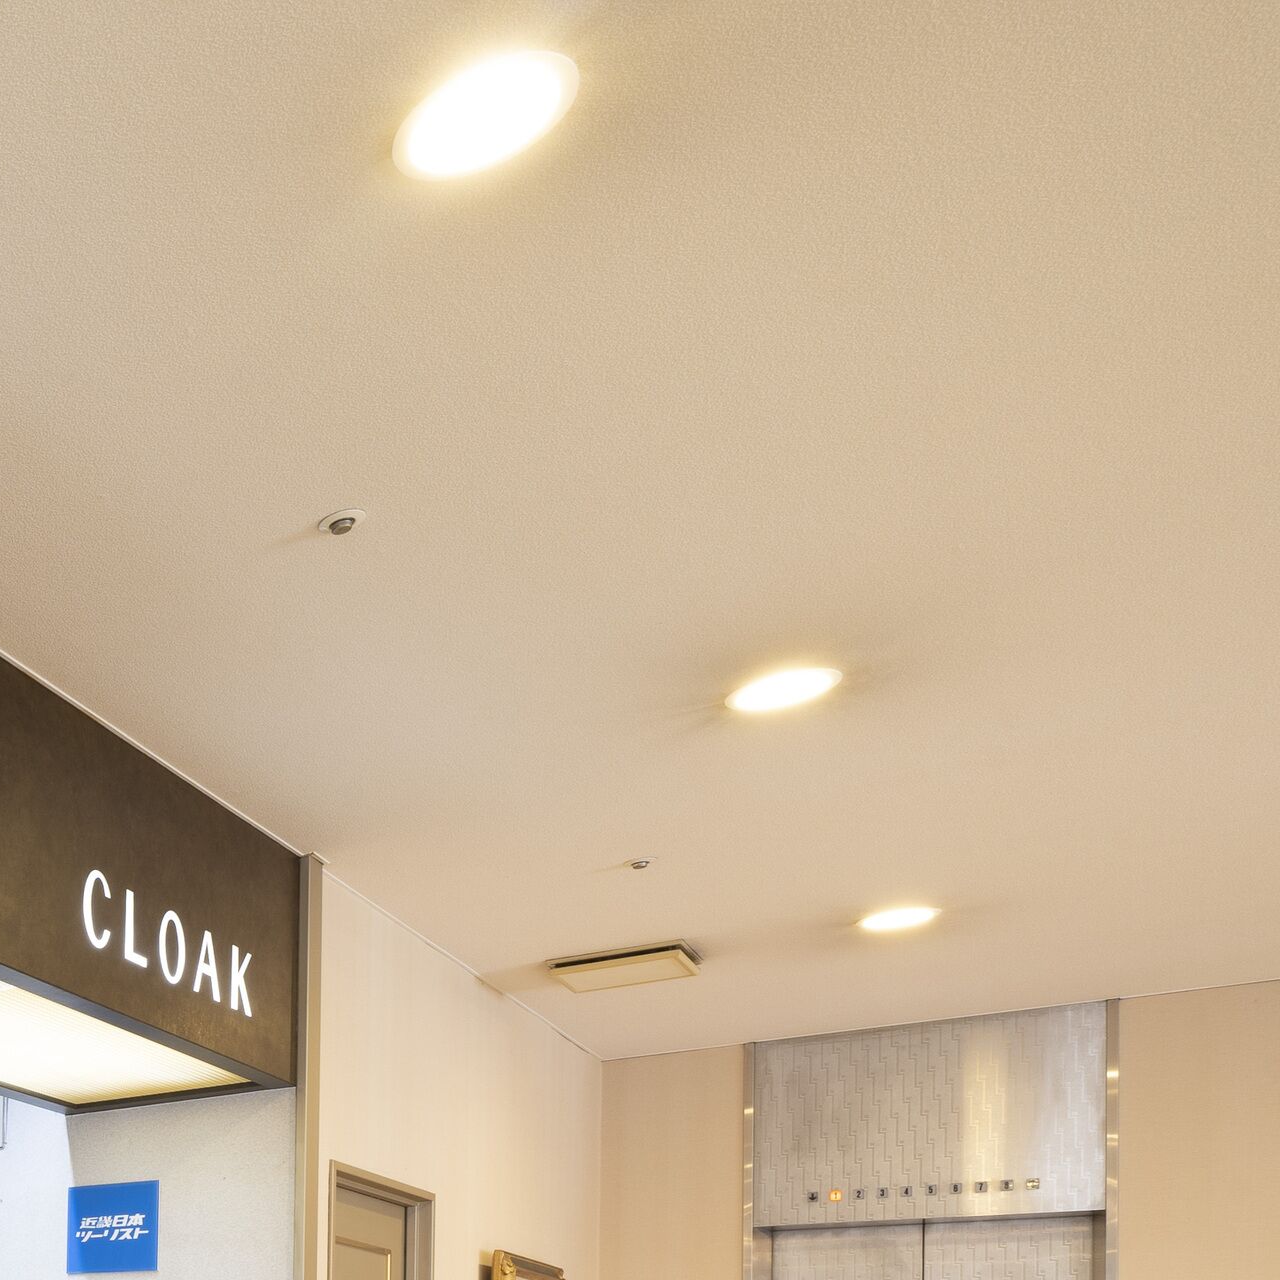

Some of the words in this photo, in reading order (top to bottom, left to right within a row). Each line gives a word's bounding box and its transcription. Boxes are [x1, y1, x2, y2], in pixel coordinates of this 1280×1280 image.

[82, 869, 252, 1018] CLOAK
[856, 1190, 862, 1198] 2
[880, 1188, 885, 1197] 3
[904, 1187, 909, 1195] 4
[928, 1185, 934, 1194] 5
[953, 1184, 958, 1192] 6
[978, 1182, 984, 1191] 7
[1004, 1181, 1009, 1190] 8
[79, 1213, 146, 1230] 近畿日本
[75, 1227, 150, 1243] ツーリスト
